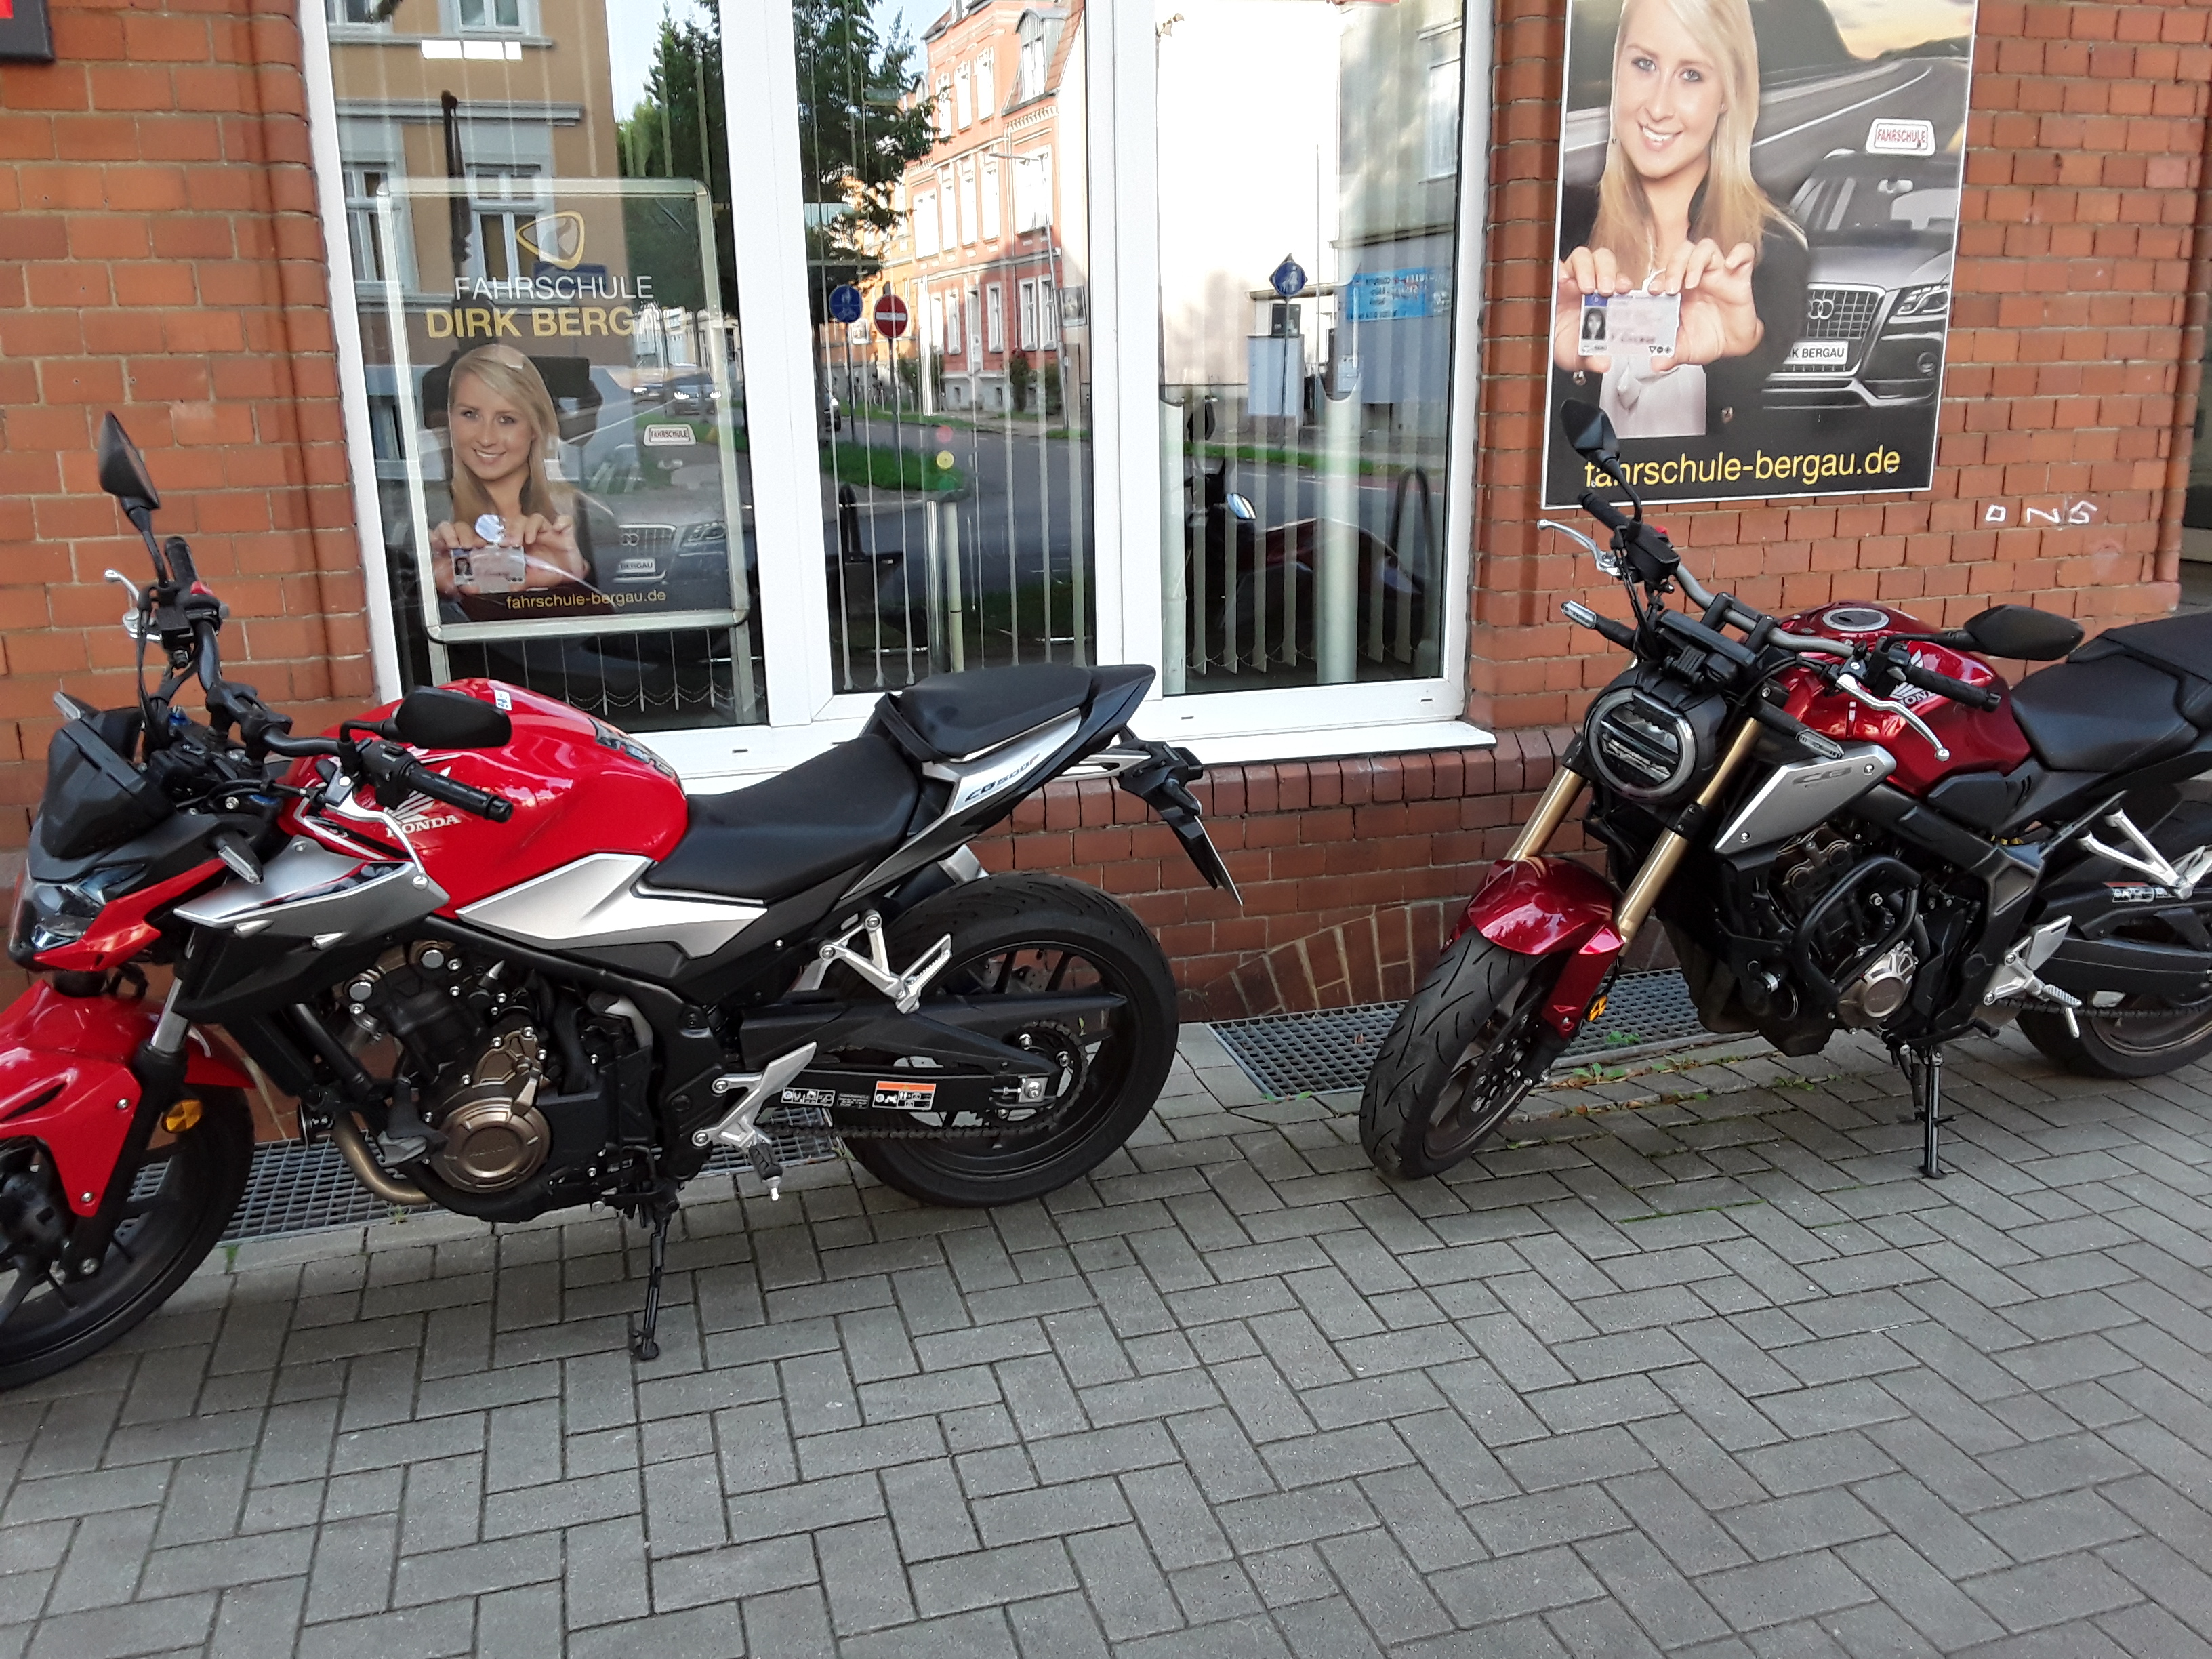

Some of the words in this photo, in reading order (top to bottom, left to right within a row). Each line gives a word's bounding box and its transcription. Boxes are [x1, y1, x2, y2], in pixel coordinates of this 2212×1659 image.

[1877, 129, 1927, 143] FAHRSCHULE
[455, 275, 655, 300] FAHRSCHULE
[426, 307, 523, 339] DIRK
[532, 305, 644, 338] BERG
[1801, 347, 1845, 359] BERGAU
[506, 588, 668, 610] fahrschule-bergau.de
